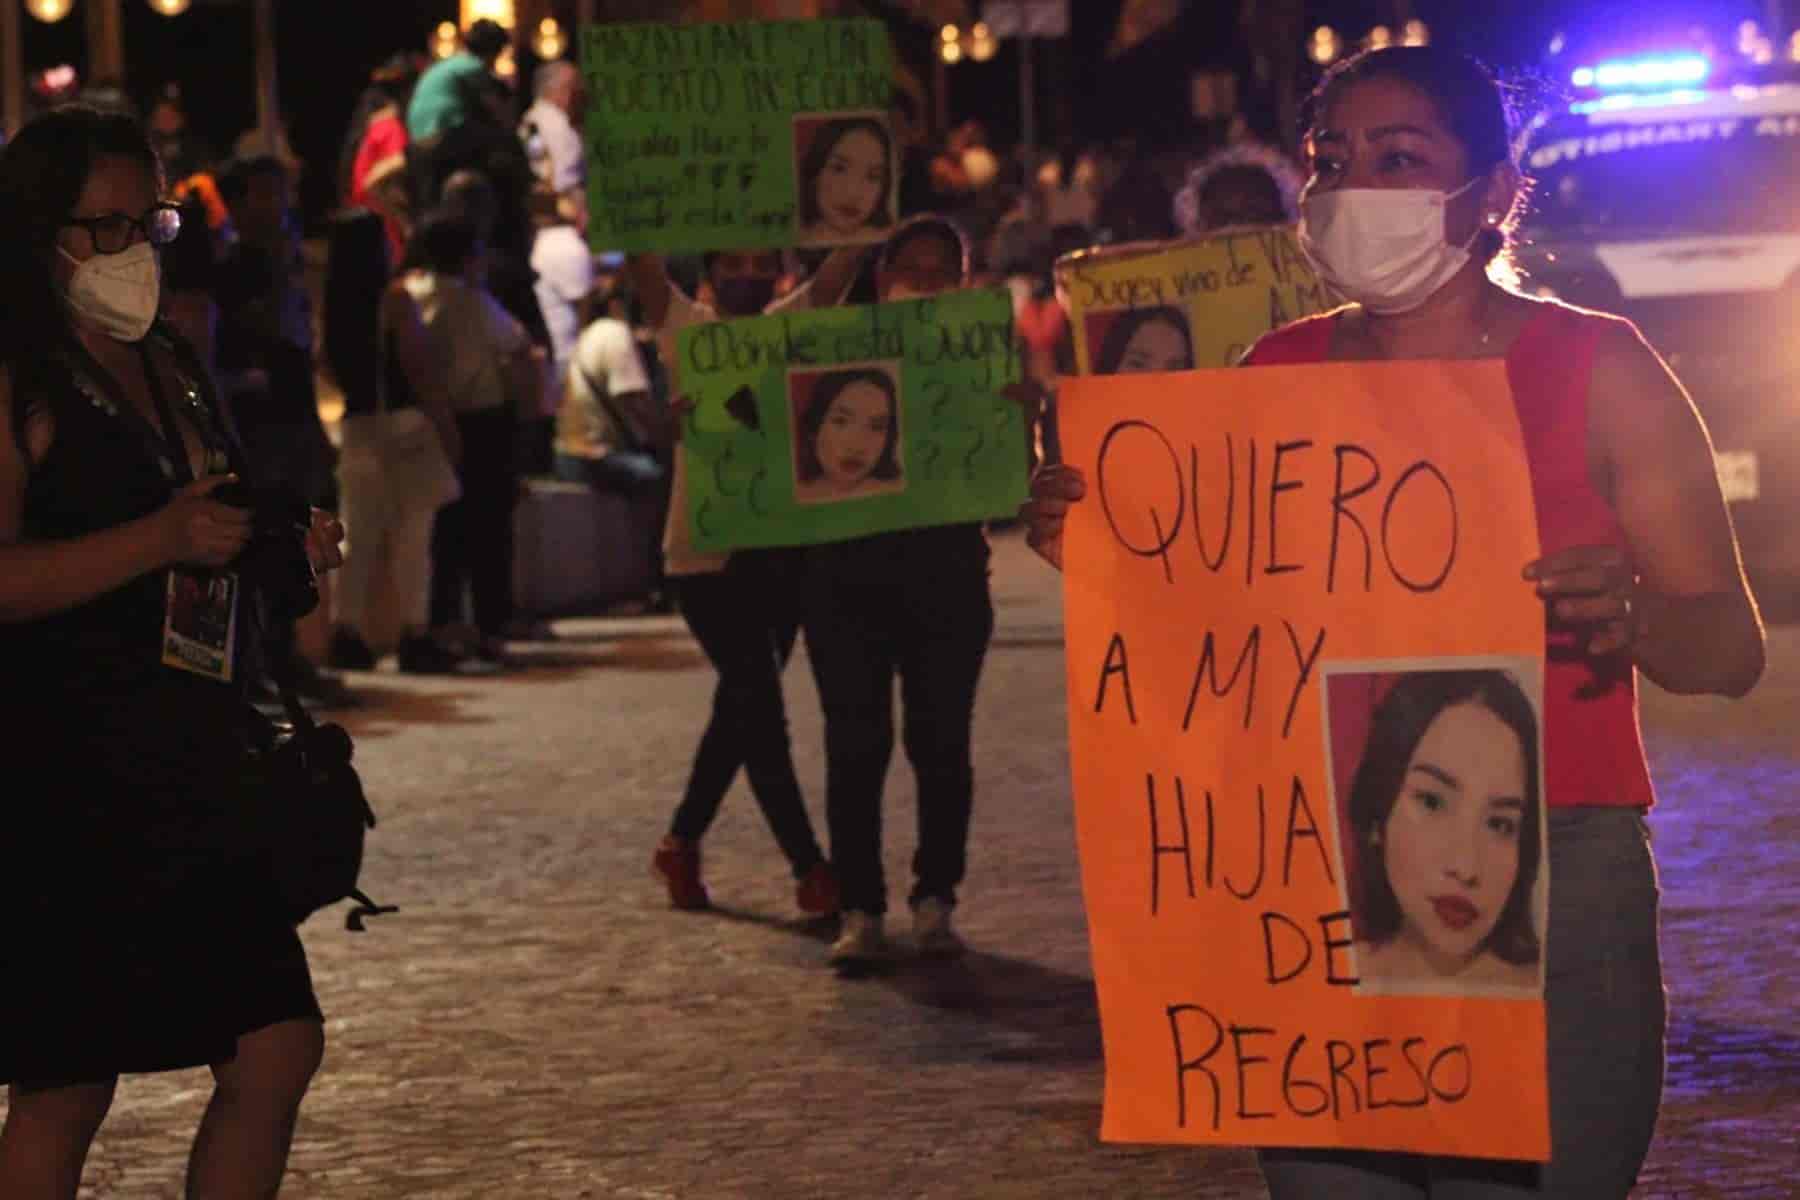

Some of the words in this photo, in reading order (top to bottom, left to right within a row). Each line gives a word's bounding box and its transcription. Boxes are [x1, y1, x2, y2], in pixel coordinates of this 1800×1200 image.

[1226, 236, 1256, 287] de
[1097, 420, 1457, 592] QUIERO
[1095, 632, 1137, 725] A
[1182, 619, 1326, 739] MY
[1147, 773, 1336, 916] HIJA
[1261, 911, 1360, 986] DE
[1167, 1003, 1472, 1131] REGRESO
